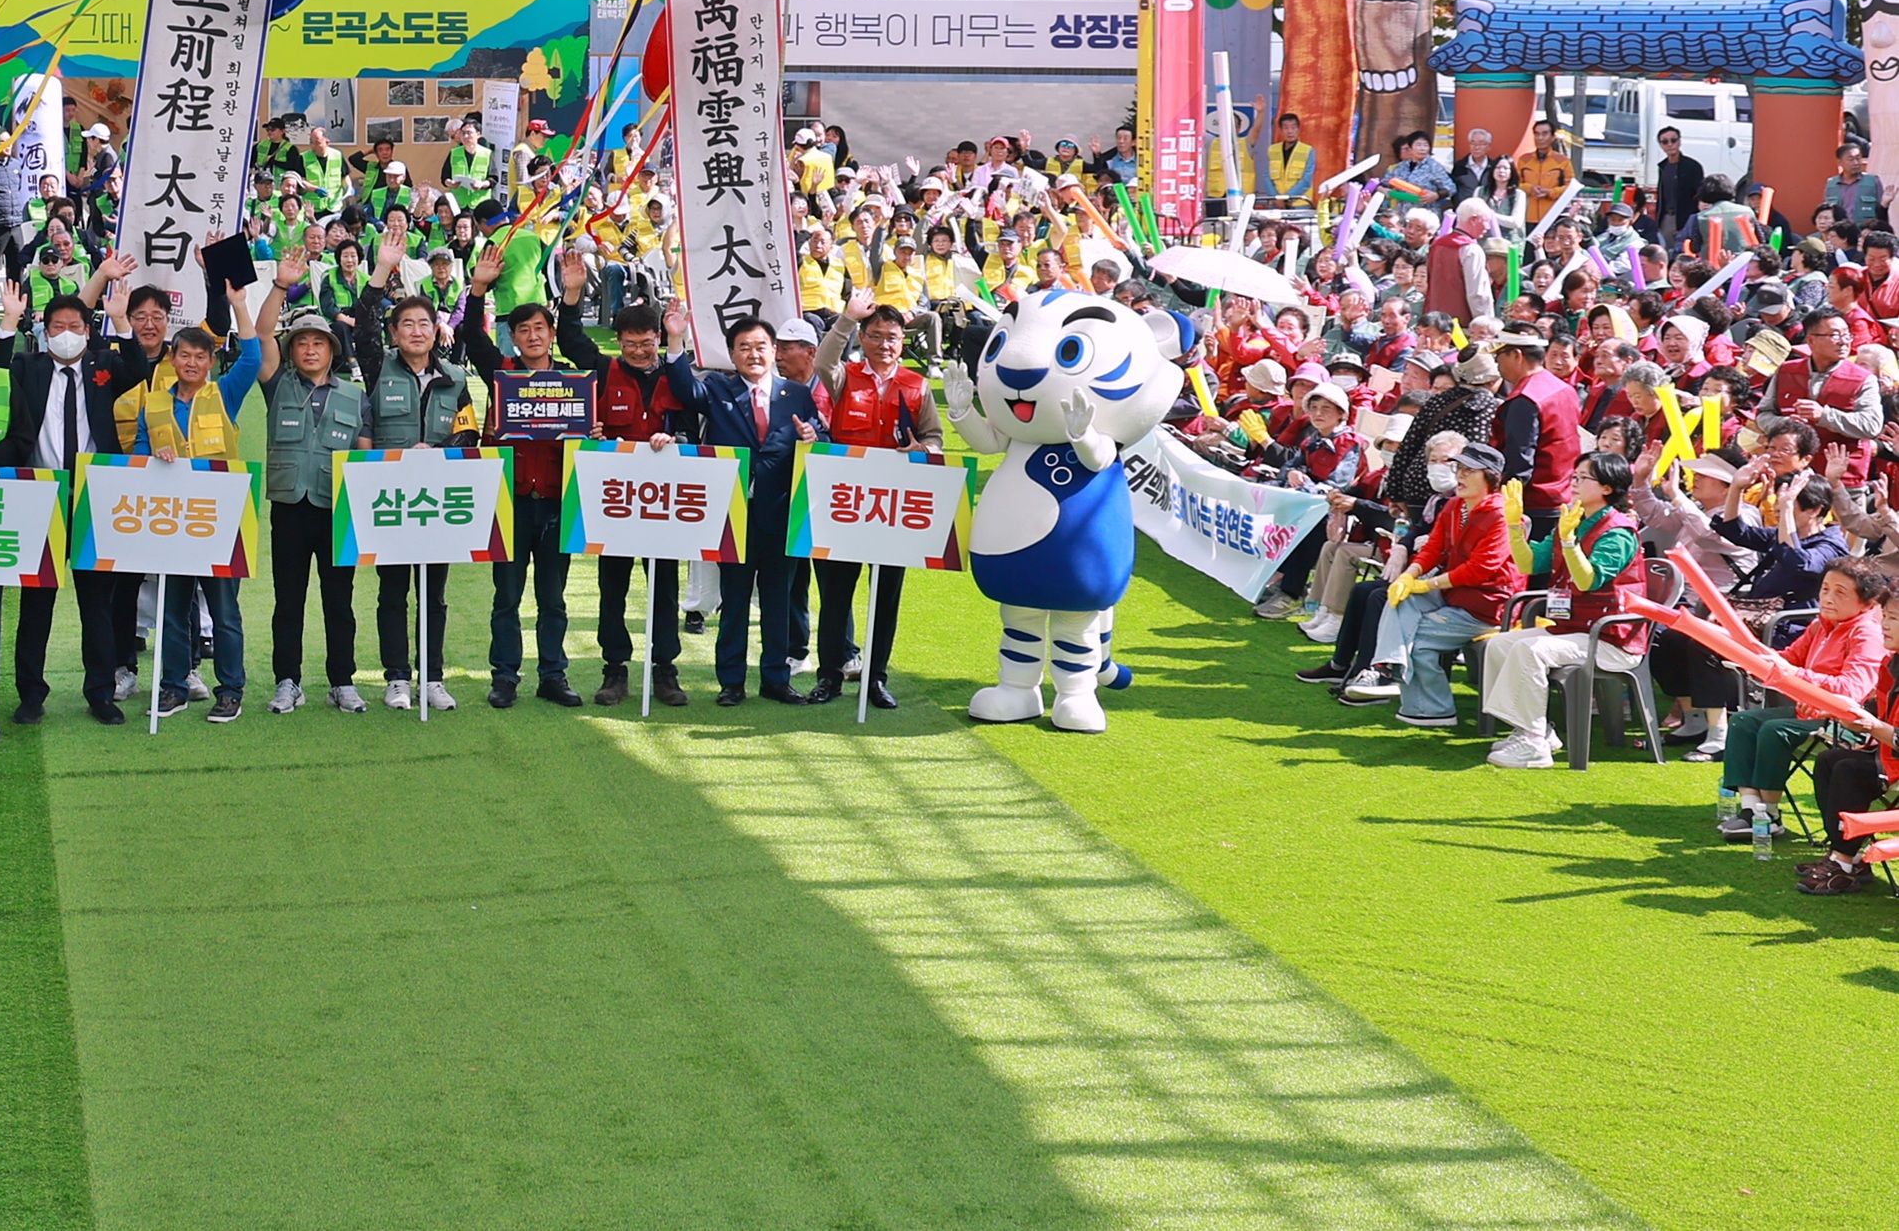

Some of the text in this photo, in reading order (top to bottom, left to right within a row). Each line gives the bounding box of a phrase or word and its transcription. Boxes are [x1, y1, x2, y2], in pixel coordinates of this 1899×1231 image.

[597, 0, 627, 9] 제44회
[302, 12, 469, 45] 문곡소도동
[814, 12, 918, 47] 행복이
[932, 14, 1037, 48] 머무는
[222, 61, 242, 117] 희망찬
[213, 127, 234, 182] 앞날을
[750, 13, 784, 296] 만가지 복이 구름처럼 일어난다
[1179, 160, 1196, 176] 그
[1161, 178, 1177, 195] 그
[1179, 184, 1196, 200] 맛
[144, 154, 205, 273] 太白
[506, 402, 585, 417] 한우선물세트
[112, 494, 218, 538] 상장동
[372, 486, 475, 527] 삼수동
[602, 478, 708, 523] 황연동
[830, 483, 935, 530] 황지동
